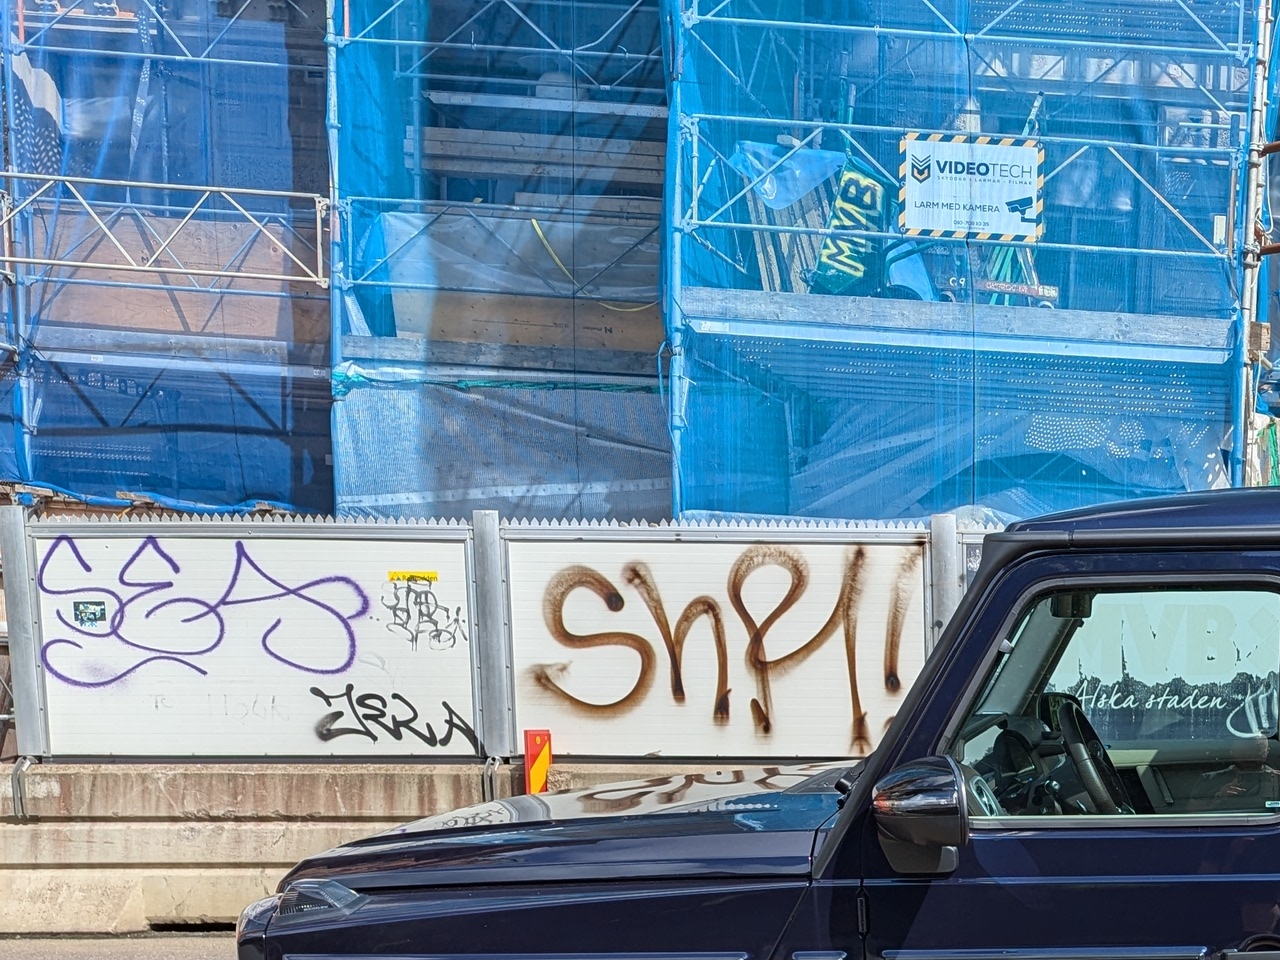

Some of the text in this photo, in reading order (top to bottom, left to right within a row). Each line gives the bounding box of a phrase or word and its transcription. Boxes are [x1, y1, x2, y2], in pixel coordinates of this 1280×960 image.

[935, 159, 1033, 179] VIDEOTECH
[914, 200, 1001, 213] LARM MED KAMERA
[1145, 686, 1228, 710] staden
